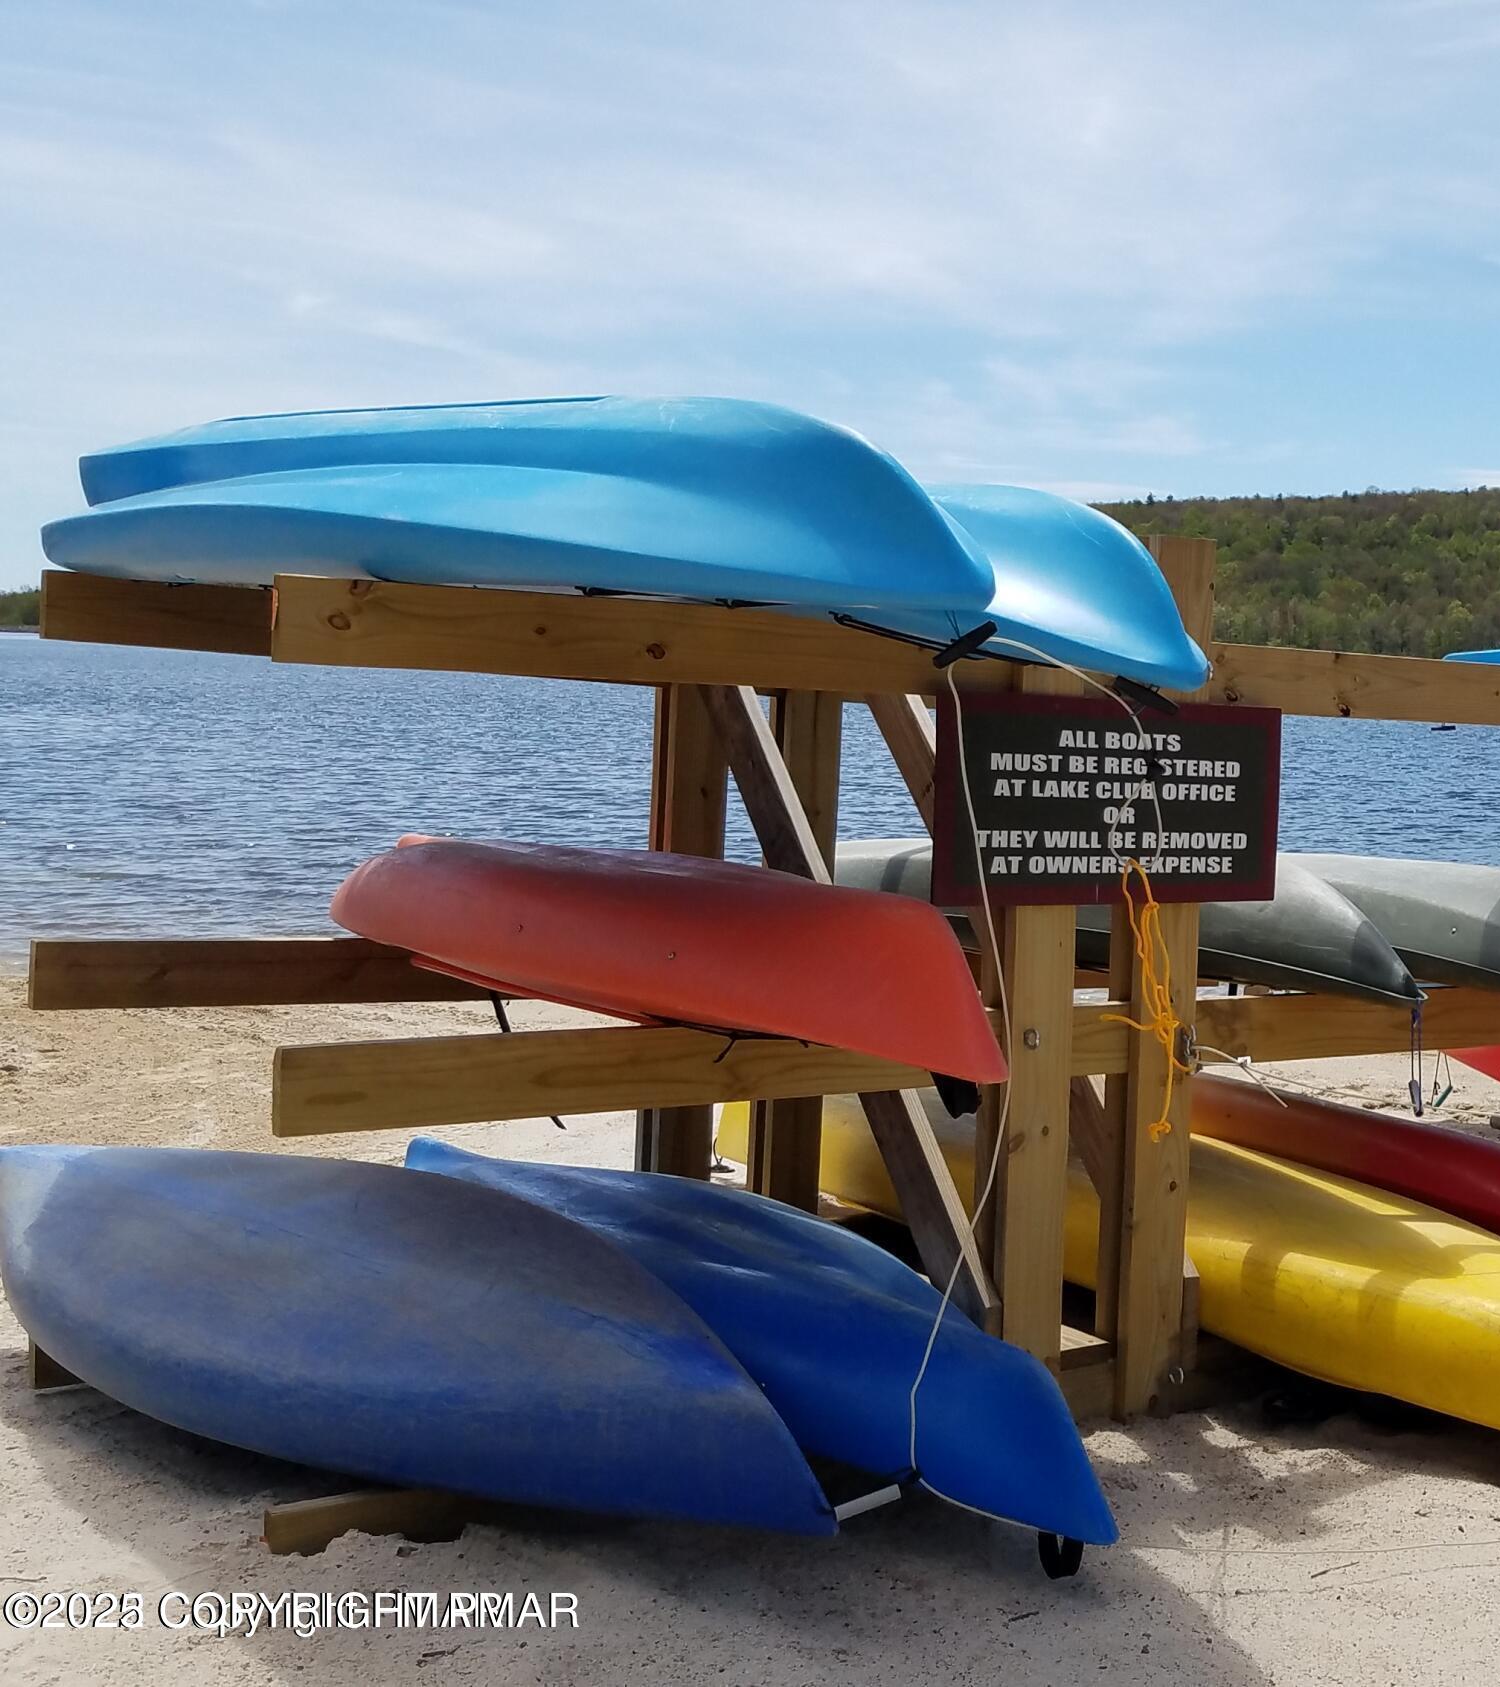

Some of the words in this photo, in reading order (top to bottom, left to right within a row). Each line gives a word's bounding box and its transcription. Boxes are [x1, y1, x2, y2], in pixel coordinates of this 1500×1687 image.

[1058, 729, 1099, 749] ALL
[1105, 731, 1182, 751] BOATS
[990, 752, 1063, 773] MUST
[1068, 755, 1099, 774] BE
[1104, 757, 1241, 778] REGSTERED
[993, 778, 1026, 798] AT
[1031, 779, 1090, 799] LAKE
[1096, 780, 1154, 800] CLUB
[1161, 783, 1236, 802] OFFICE
[1103, 806, 1136, 824] OR
[977, 830, 1039, 849] THEY
[1043, 830, 1102, 849] WILL
[1108, 831, 1137, 849] BE
[1142, 832, 1248, 850] REMOVED
[990, 856, 1023, 874] AT
[1028, 855, 1133, 875] OWNERS
[1139, 856, 1233, 874] EXPENSE
